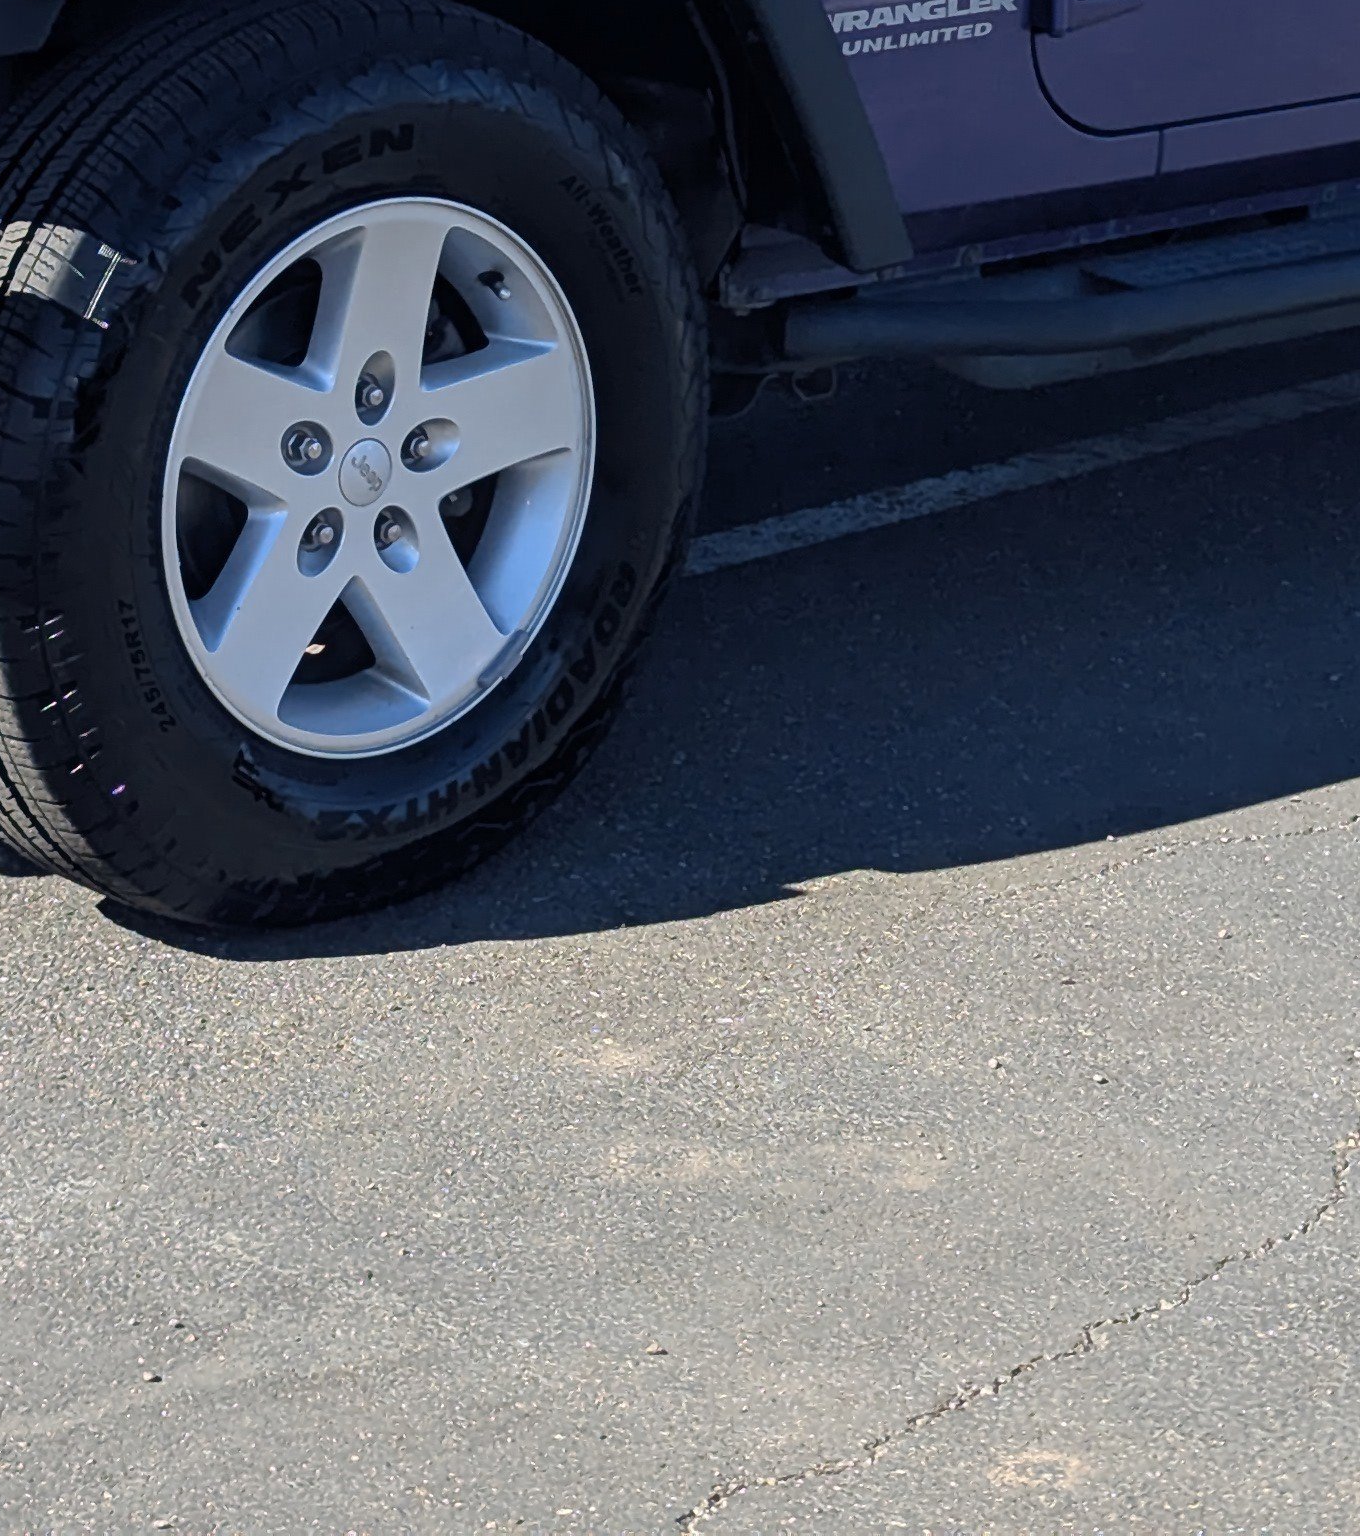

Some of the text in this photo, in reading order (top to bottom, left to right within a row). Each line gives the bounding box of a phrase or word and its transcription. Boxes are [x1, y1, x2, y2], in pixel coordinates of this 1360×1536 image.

[841, 21, 994, 57] UNLIMITED
[180, 123, 415, 309] NEXEN
[351, 454, 383, 492] Jeep
